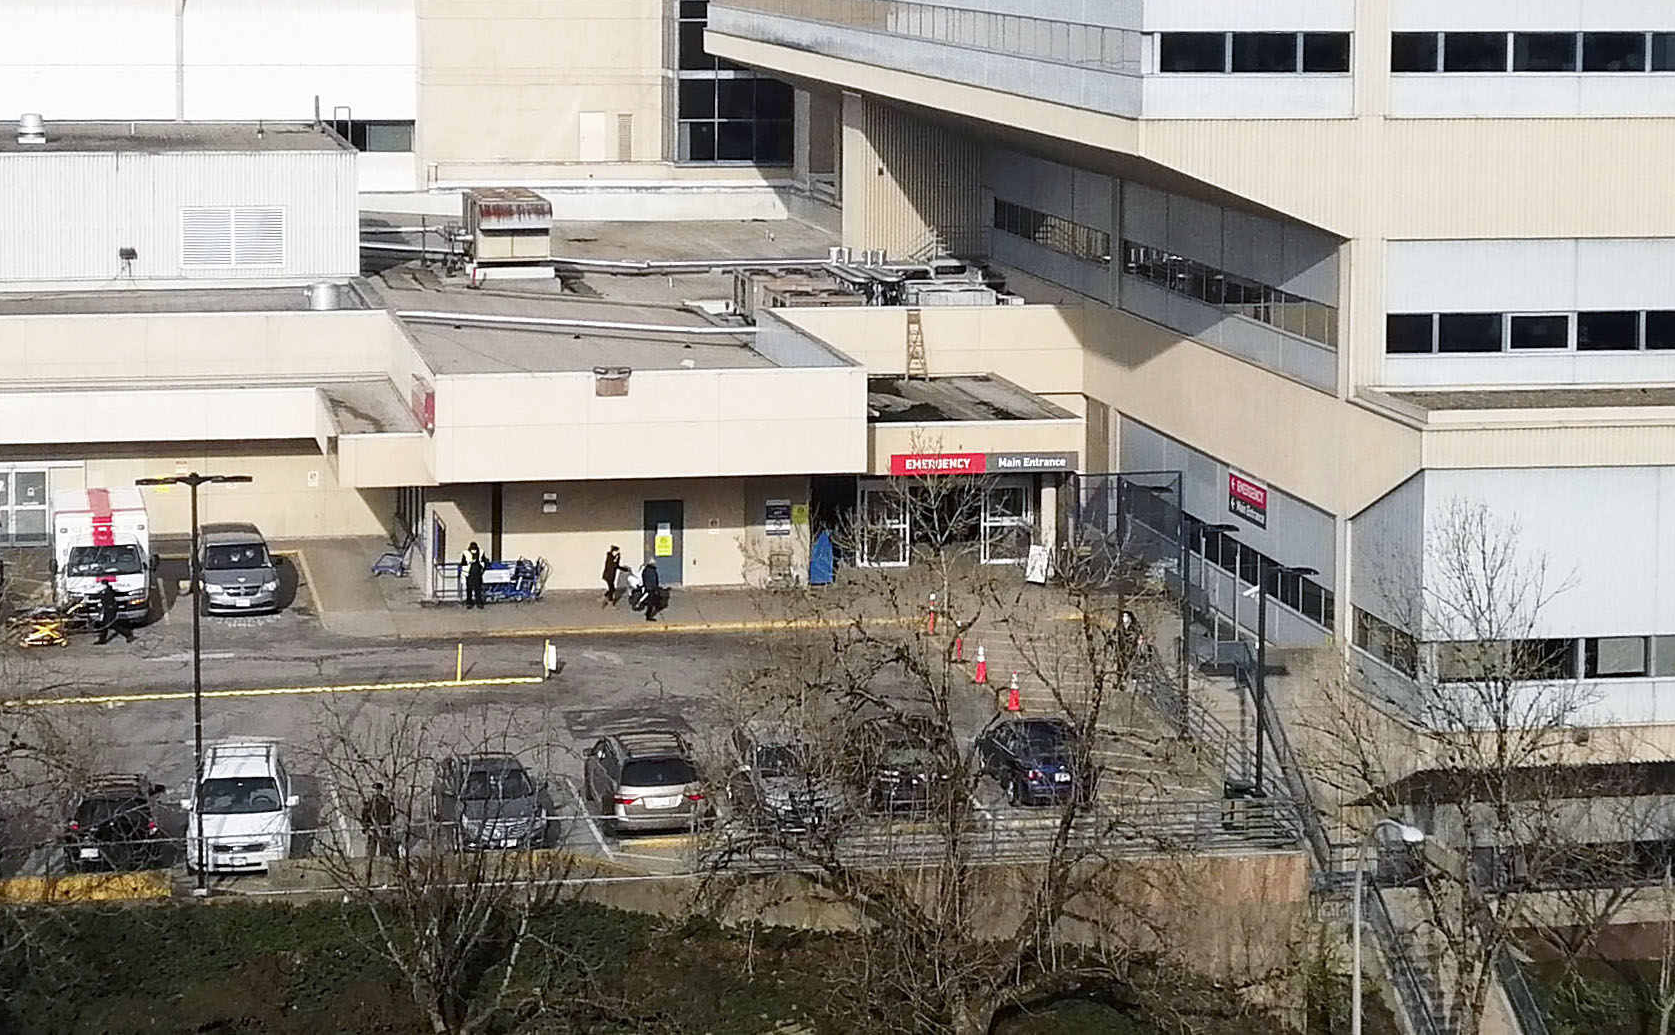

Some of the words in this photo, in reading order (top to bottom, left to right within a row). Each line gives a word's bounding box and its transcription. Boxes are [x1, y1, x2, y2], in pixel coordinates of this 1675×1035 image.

[905, 457, 971, 470] EMERGENCY
[998, 457, 1022, 468] Main
[1024, 457, 1066, 467] Entrance
